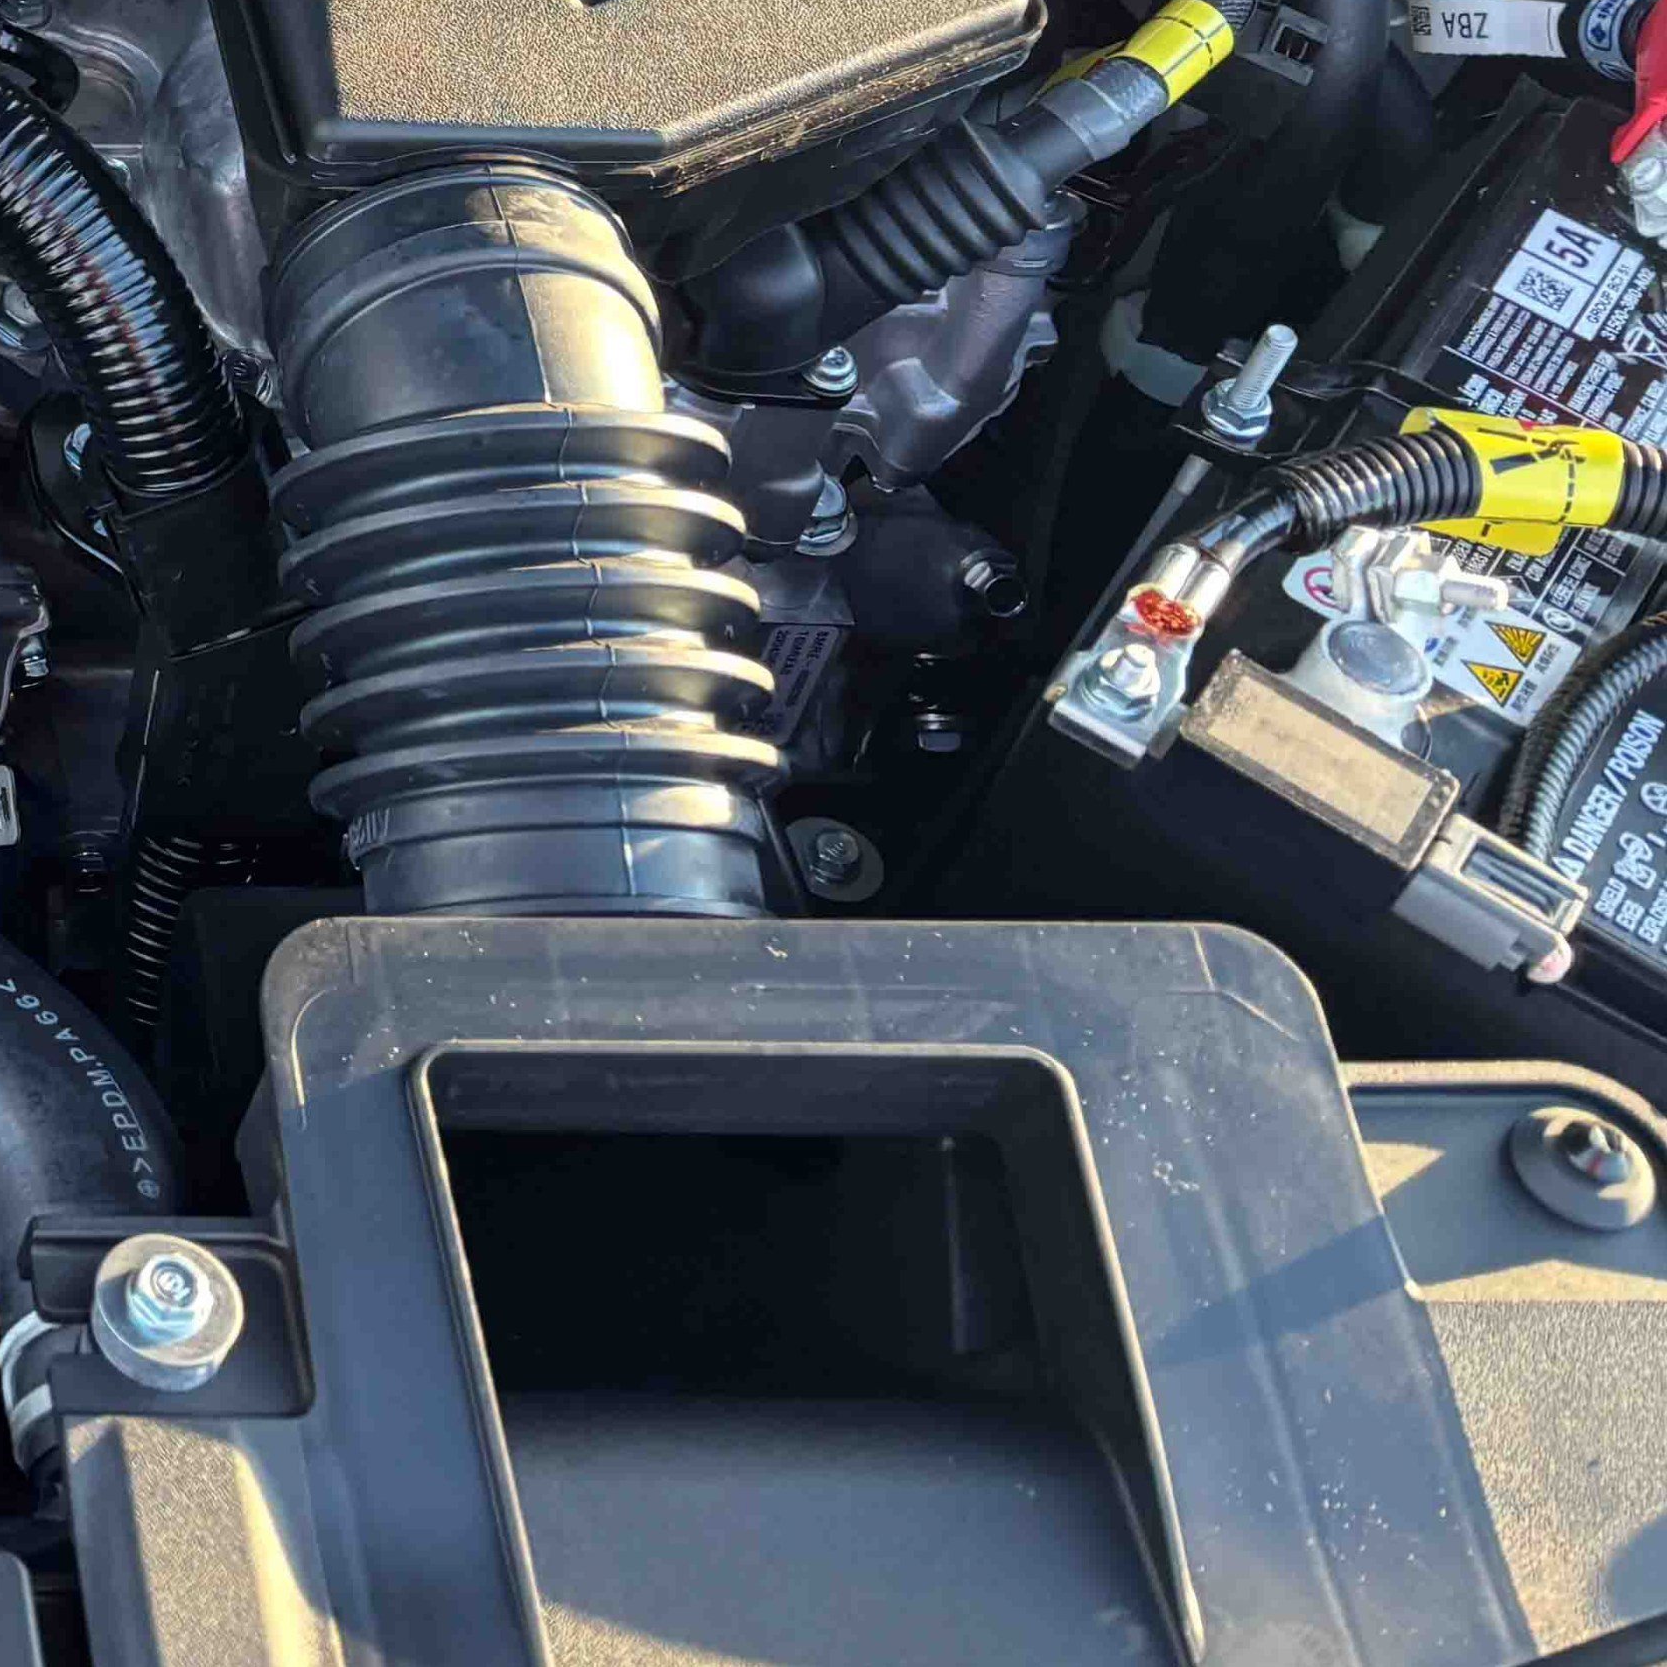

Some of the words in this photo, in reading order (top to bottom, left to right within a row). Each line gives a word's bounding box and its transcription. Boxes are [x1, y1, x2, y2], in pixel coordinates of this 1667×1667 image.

[1441, 12, 1489, 40] ZBA
[1544, 225, 1603, 269] 5A
[1586, 290, 1611, 325] GROUP
